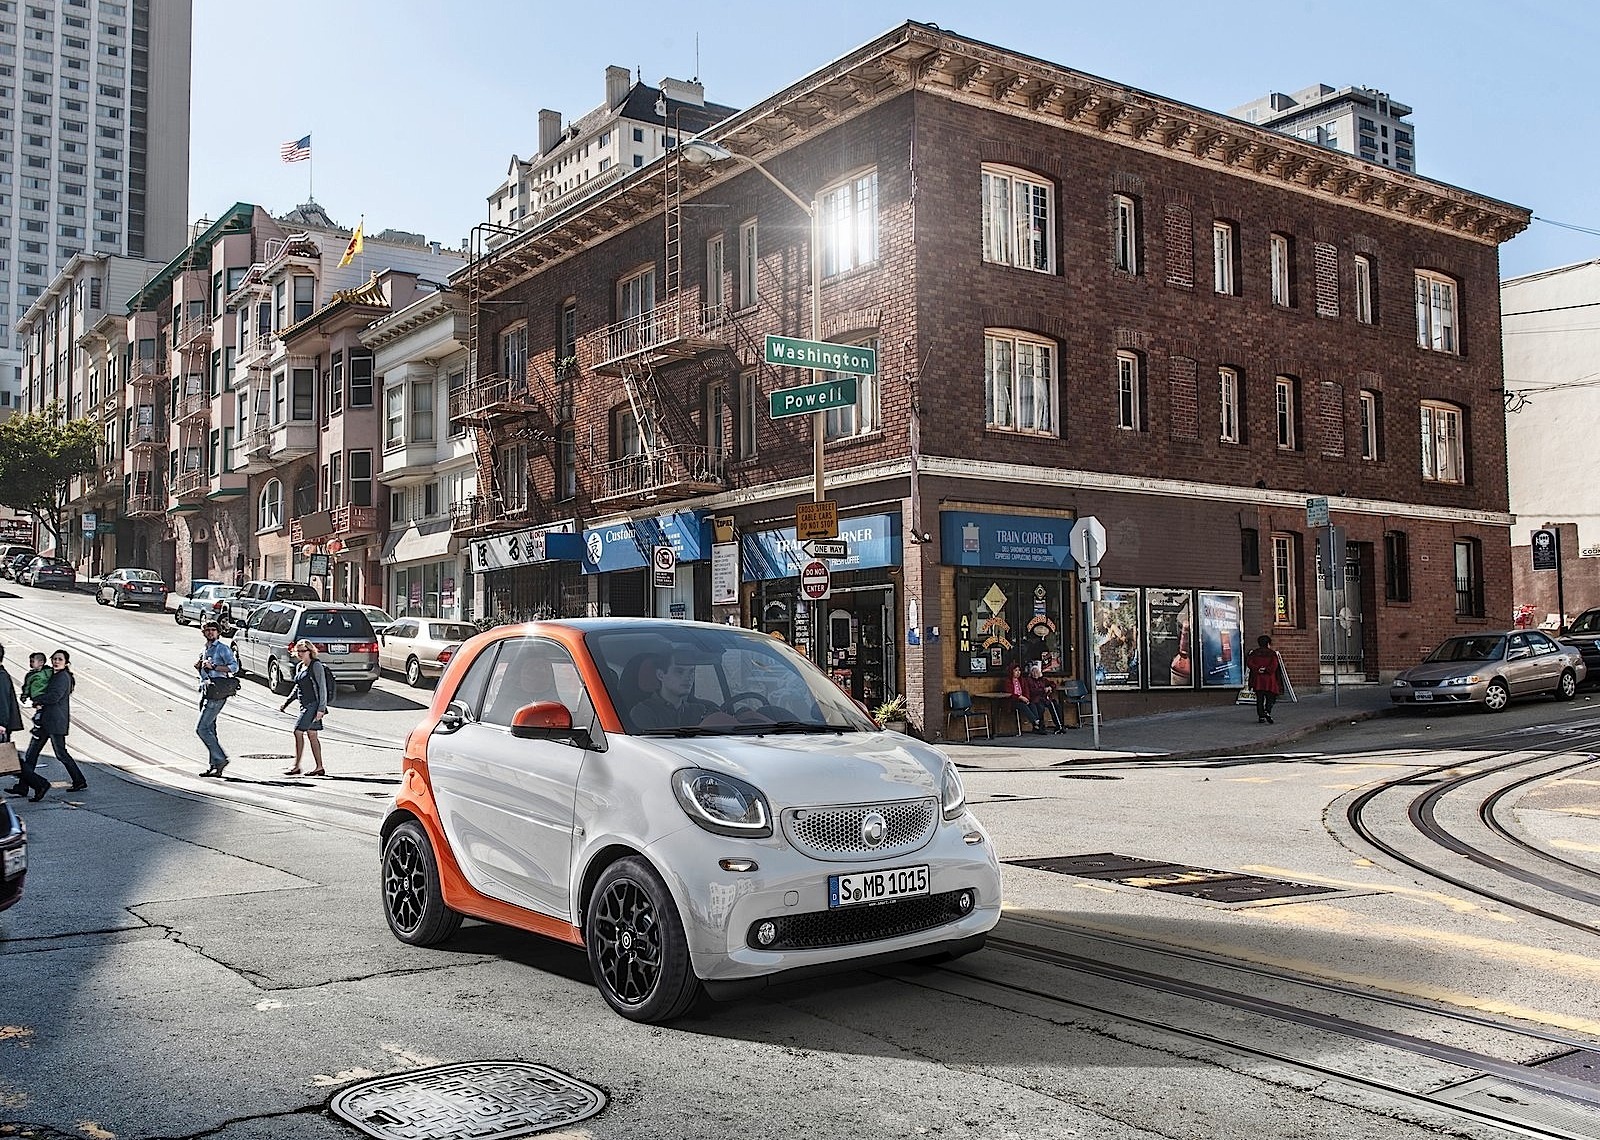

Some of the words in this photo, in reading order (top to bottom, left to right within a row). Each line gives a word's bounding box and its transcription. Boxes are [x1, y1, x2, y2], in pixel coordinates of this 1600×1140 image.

[772, 342, 869, 369] Washington
[785, 387, 841, 409] Powell
[799, 505, 814, 514] CROSS
[816, 503, 835, 511] STREET
[801, 513, 816, 521] CABLE
[819, 511, 832, 519] CARS
[821, 520, 834, 528] STOP
[606, 529, 636, 543] Custom
[841, 528, 873, 543] RNER
[996, 530, 1019, 543] TRAIN
[1021, 531, 1054, 545] CORNER
[815, 545, 828, 553] ONE
[829, 545, 842, 553] WAY
[960, 615, 970, 652] ATM
[832, 893, 838, 901] D
[841, 878, 852, 901] S
[863, 874, 886, 899] MB
[888, 868, 927, 895] 1015
